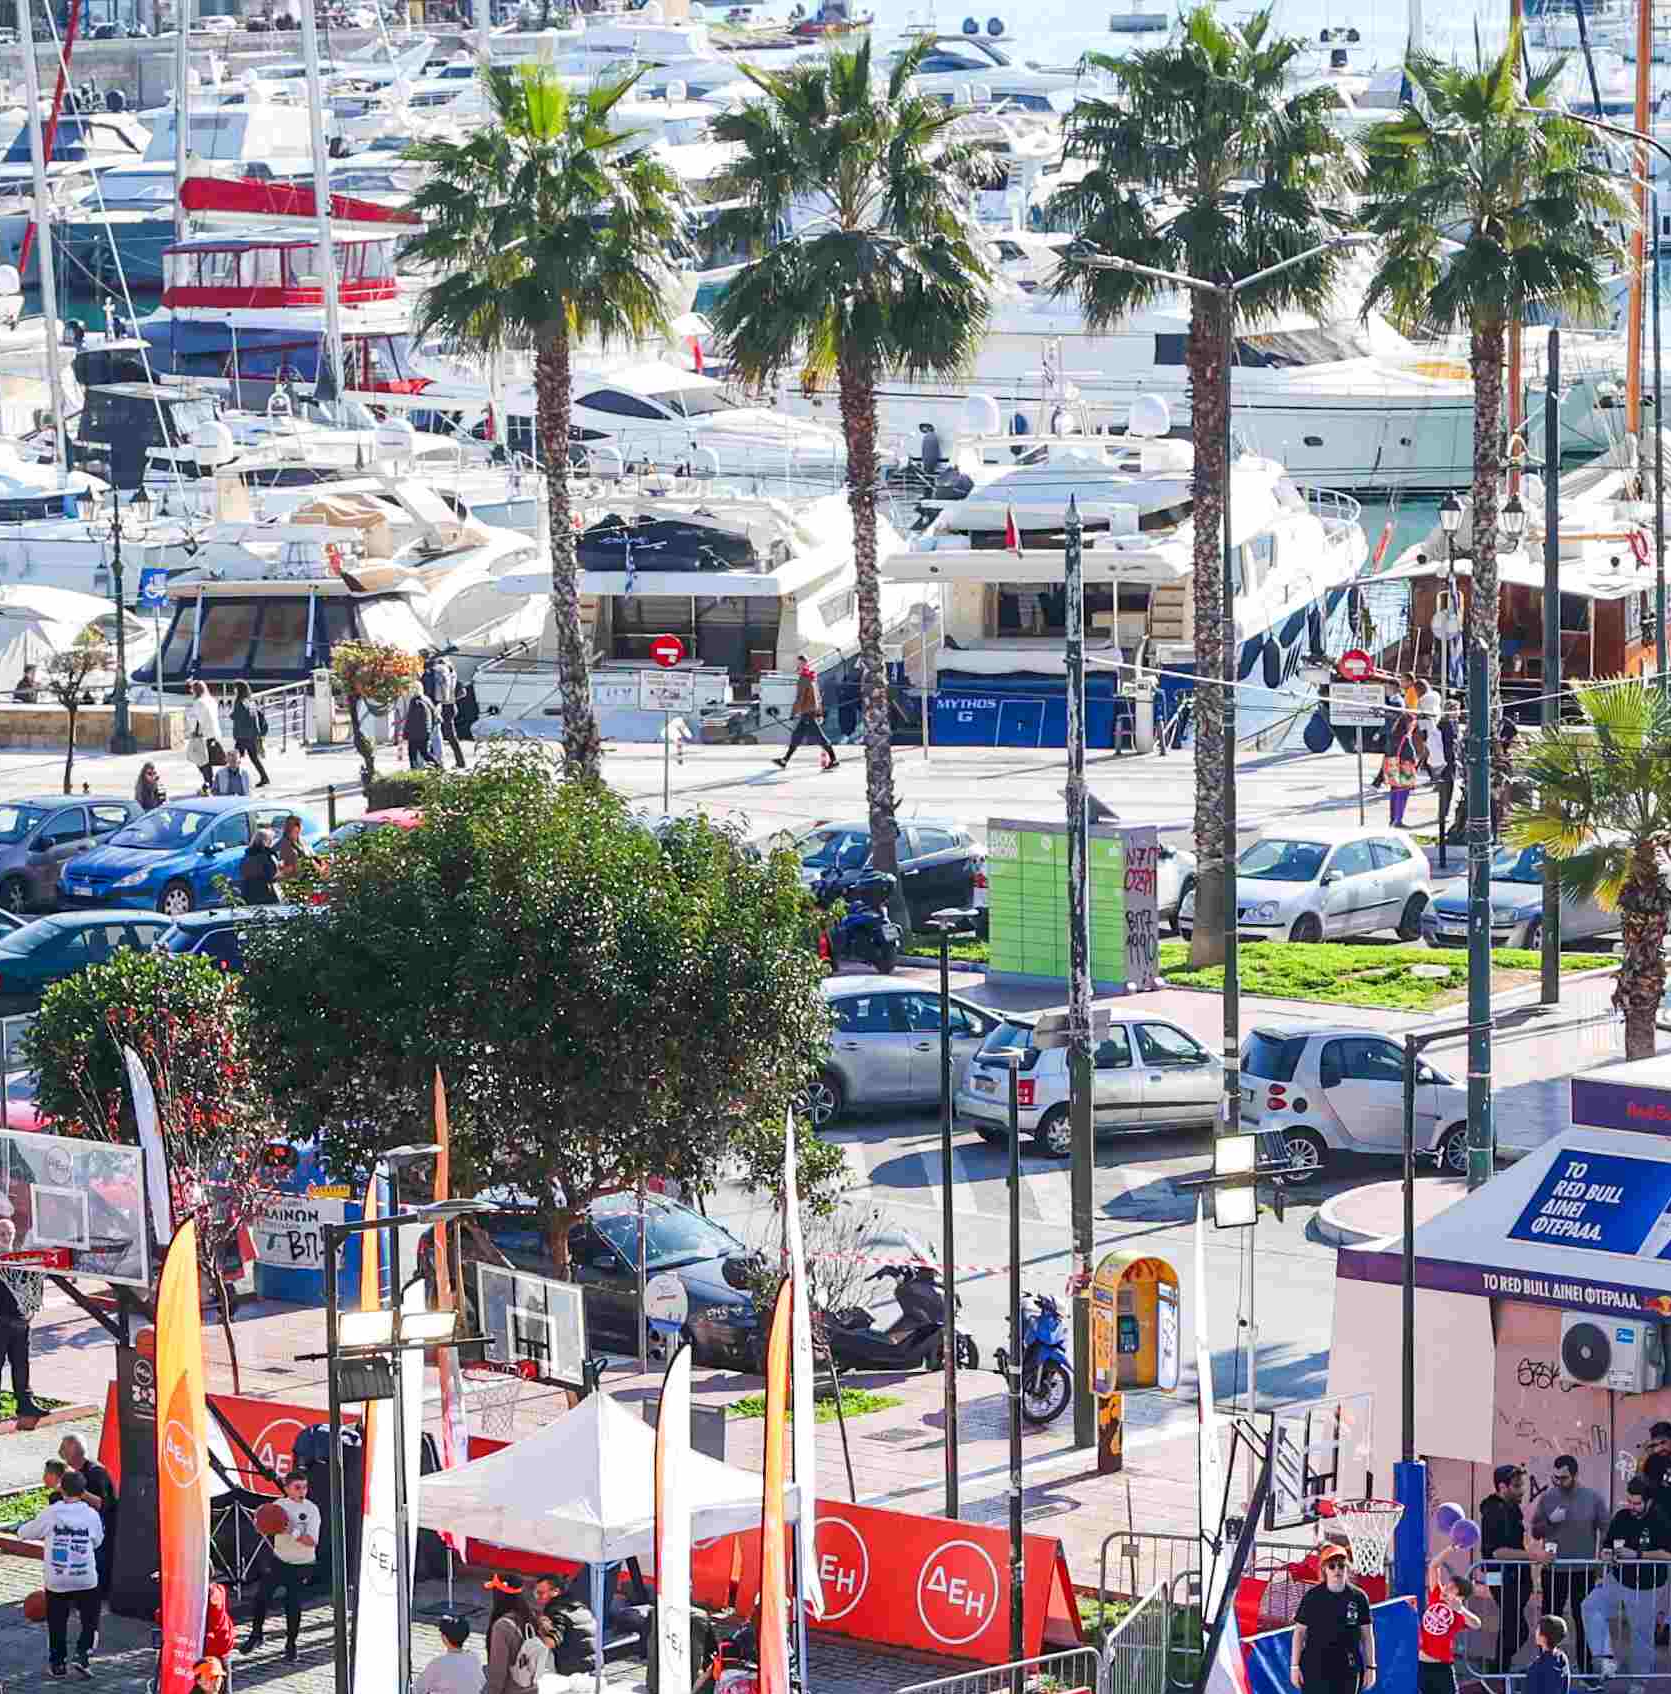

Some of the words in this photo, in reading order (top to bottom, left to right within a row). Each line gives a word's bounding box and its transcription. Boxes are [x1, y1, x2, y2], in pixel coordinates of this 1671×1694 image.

[936, 698, 998, 709] MYTHOS
[957, 711, 974, 722] G
[1552, 1181, 1587, 1198] RED
[1585, 1186, 1624, 1203] BULL
[1540, 1199, 1586, 1218] ΔΙΝΕΙ
[1499, 1277, 1521, 1294] RED
[1523, 1279, 1550, 1297] BULL
[1553, 1282, 1584, 1303] ΔΙΝΕΙ
[259, 1442, 294, 1480] ΔΕ
[819, 1555, 855, 1593] ΕΗ
[927, 1566, 985, 1618] ΔΕΗ
